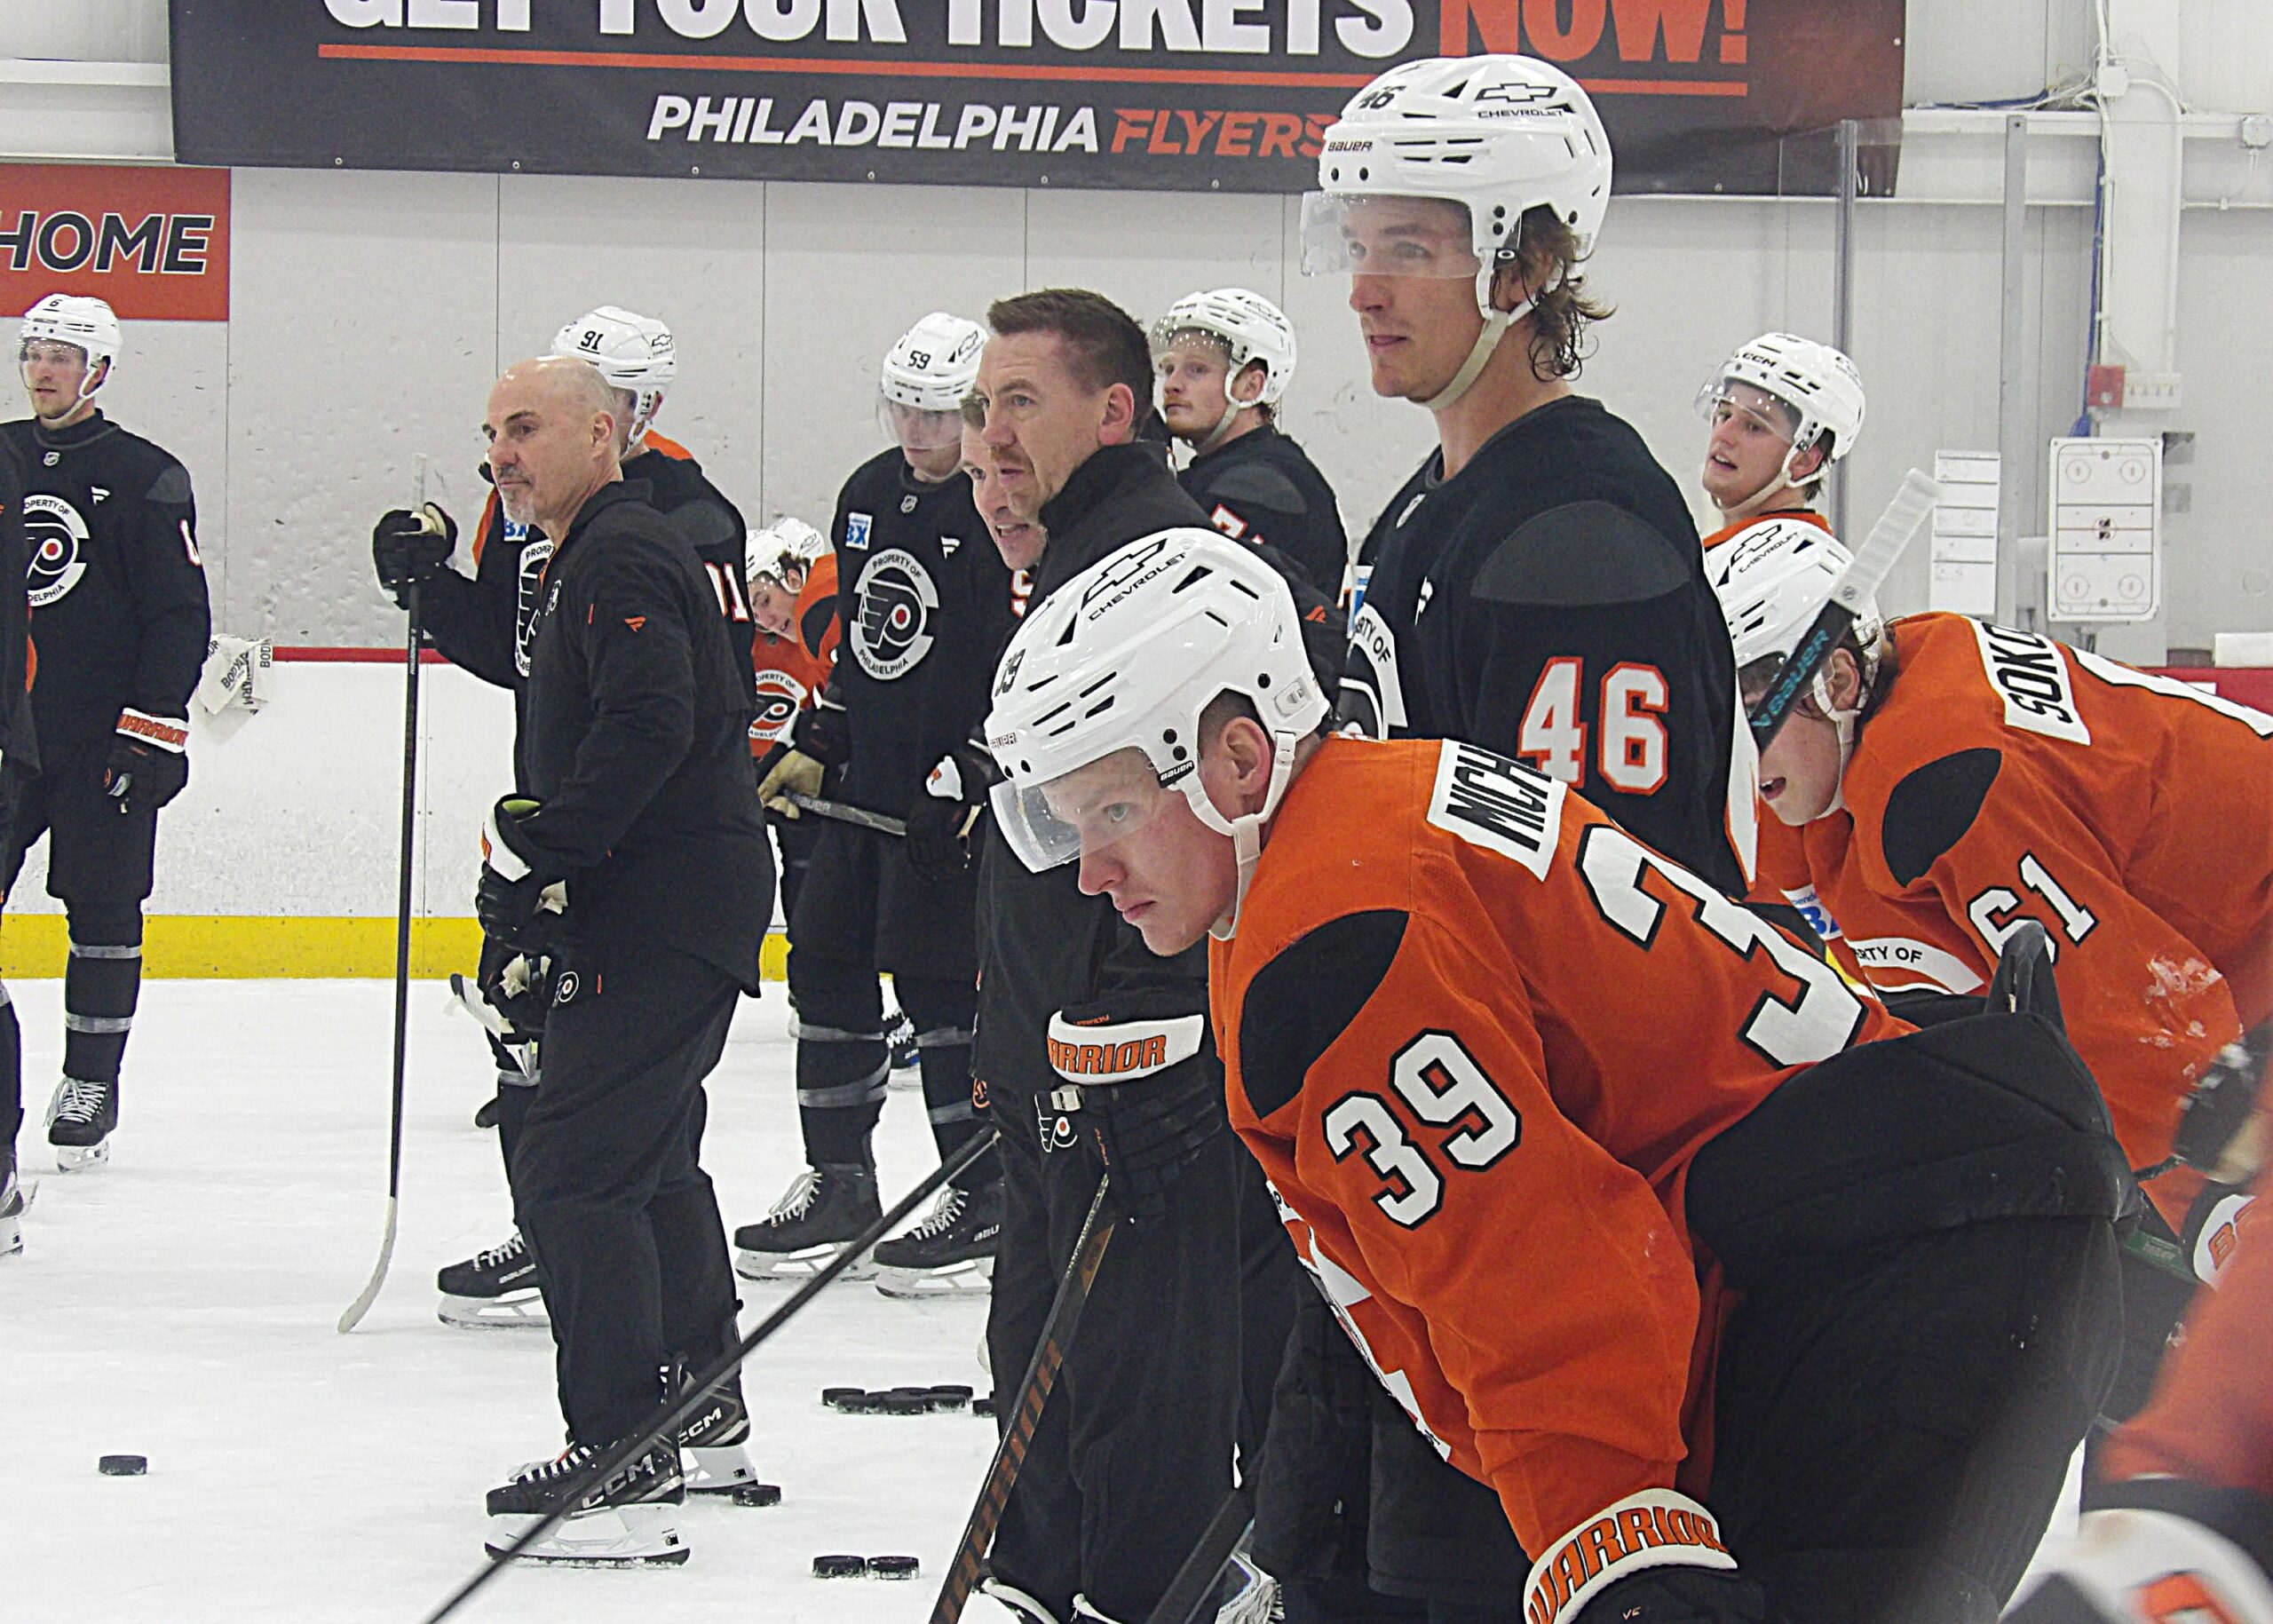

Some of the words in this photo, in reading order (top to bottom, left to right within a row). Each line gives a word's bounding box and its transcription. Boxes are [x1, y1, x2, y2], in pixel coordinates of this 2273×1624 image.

[1477, 109, 1563, 118] CHEVROLET
[646, 95, 1098, 153] PHILADELPHIA
[1112, 108, 1339, 158] FLYERS
[0, 211, 216, 274] HOME
[581, 330, 604, 351] 91
[907, 350, 931, 369] 59
[1741, 352, 1777, 368] CCM
[59, 504, 70, 517] OF
[872, 554, 911, 571] PROPERTY
[910, 565, 922, 578] OF
[1088, 551, 1186, 622] CHEVROLET
[1373, 636, 1391, 662] OF
[859, 650, 909, 675] PHILADELPHIA
[1517, 655, 1669, 796] 46
[1160, 760, 1194, 783] BAUER
[1445, 744, 1552, 853] MICH
[1966, 850, 2102, 967] 61
[1895, 947, 1923, 964] OF
[1322, 1028, 1521, 1230] 39
[1528, 1506, 1730, 1624] WARRIOR
